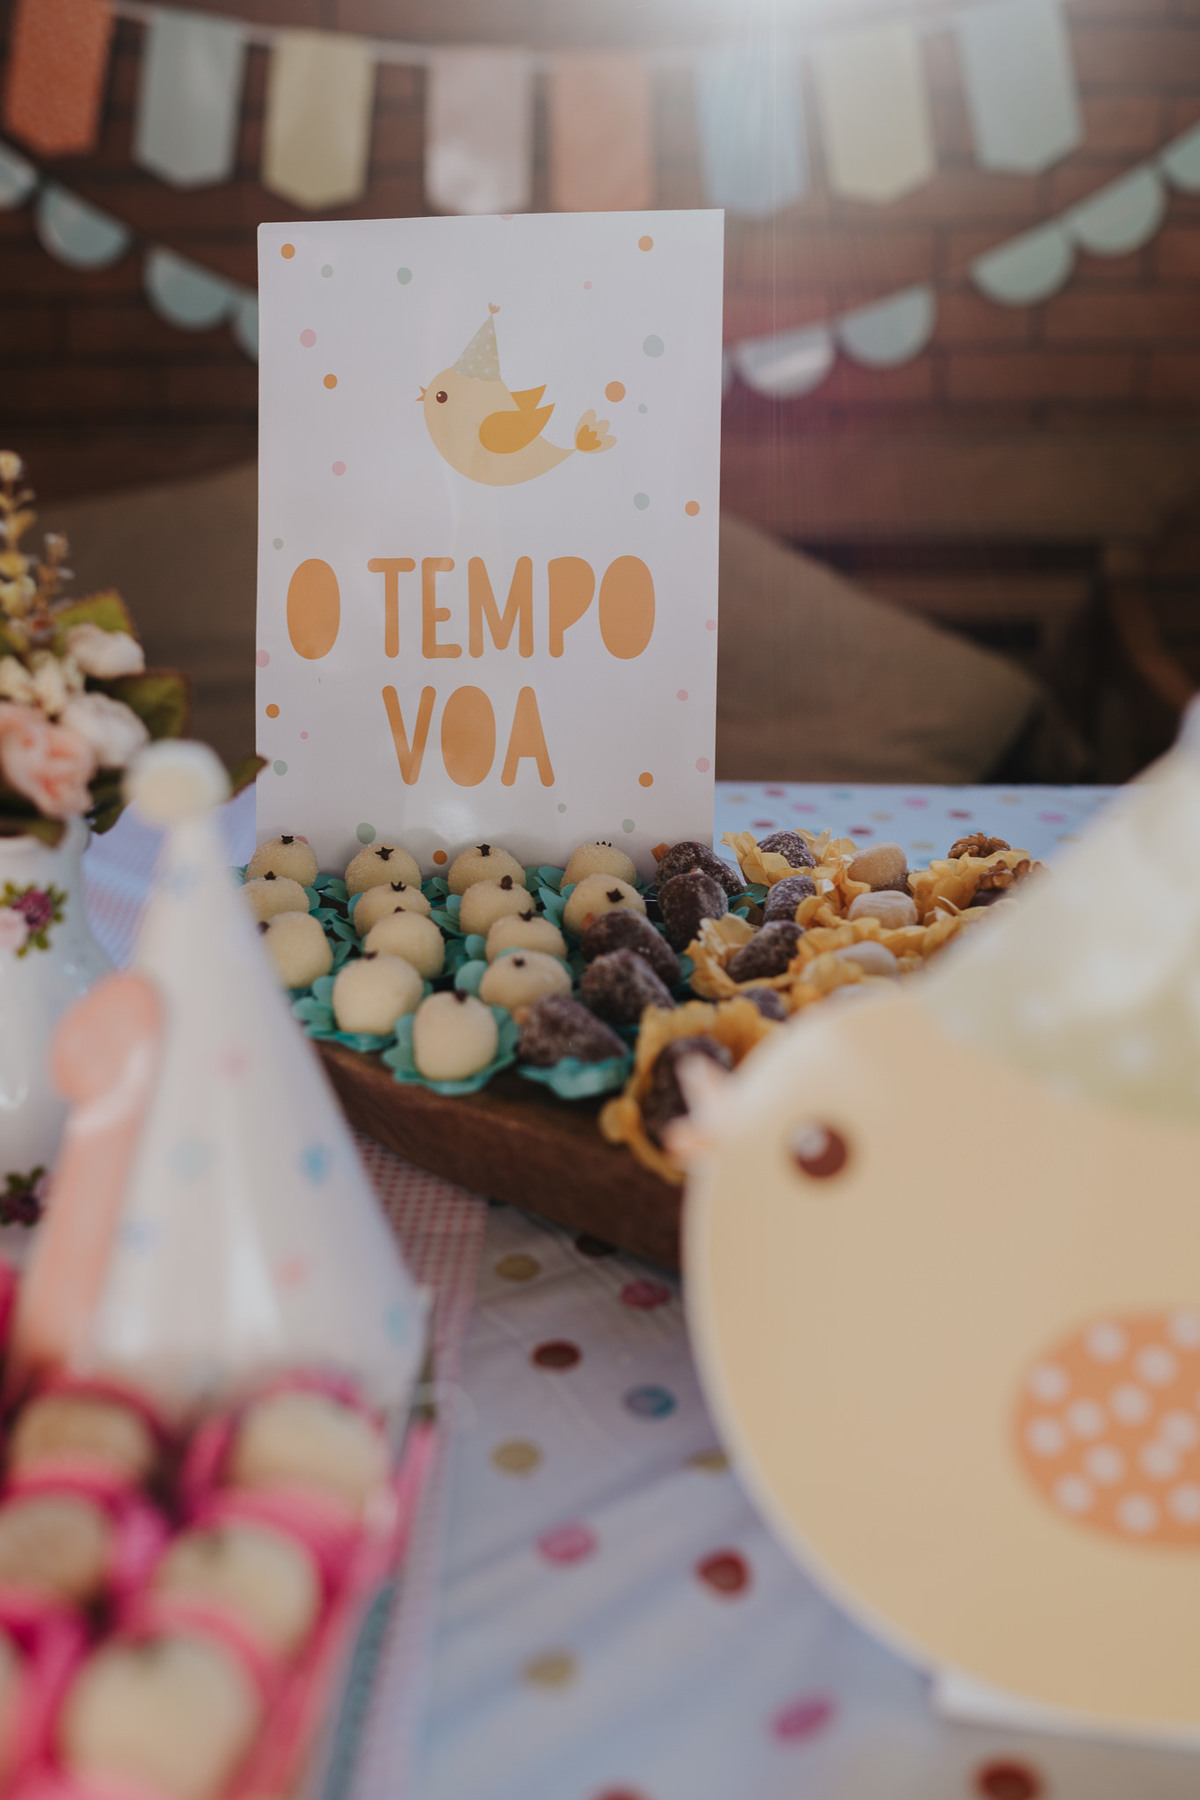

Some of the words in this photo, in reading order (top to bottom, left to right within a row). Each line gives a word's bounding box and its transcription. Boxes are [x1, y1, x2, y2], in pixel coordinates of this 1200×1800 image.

[287, 558, 340, 659] O
[368, 556, 655, 659] TEMPO
[382, 686, 554, 787] VOA
